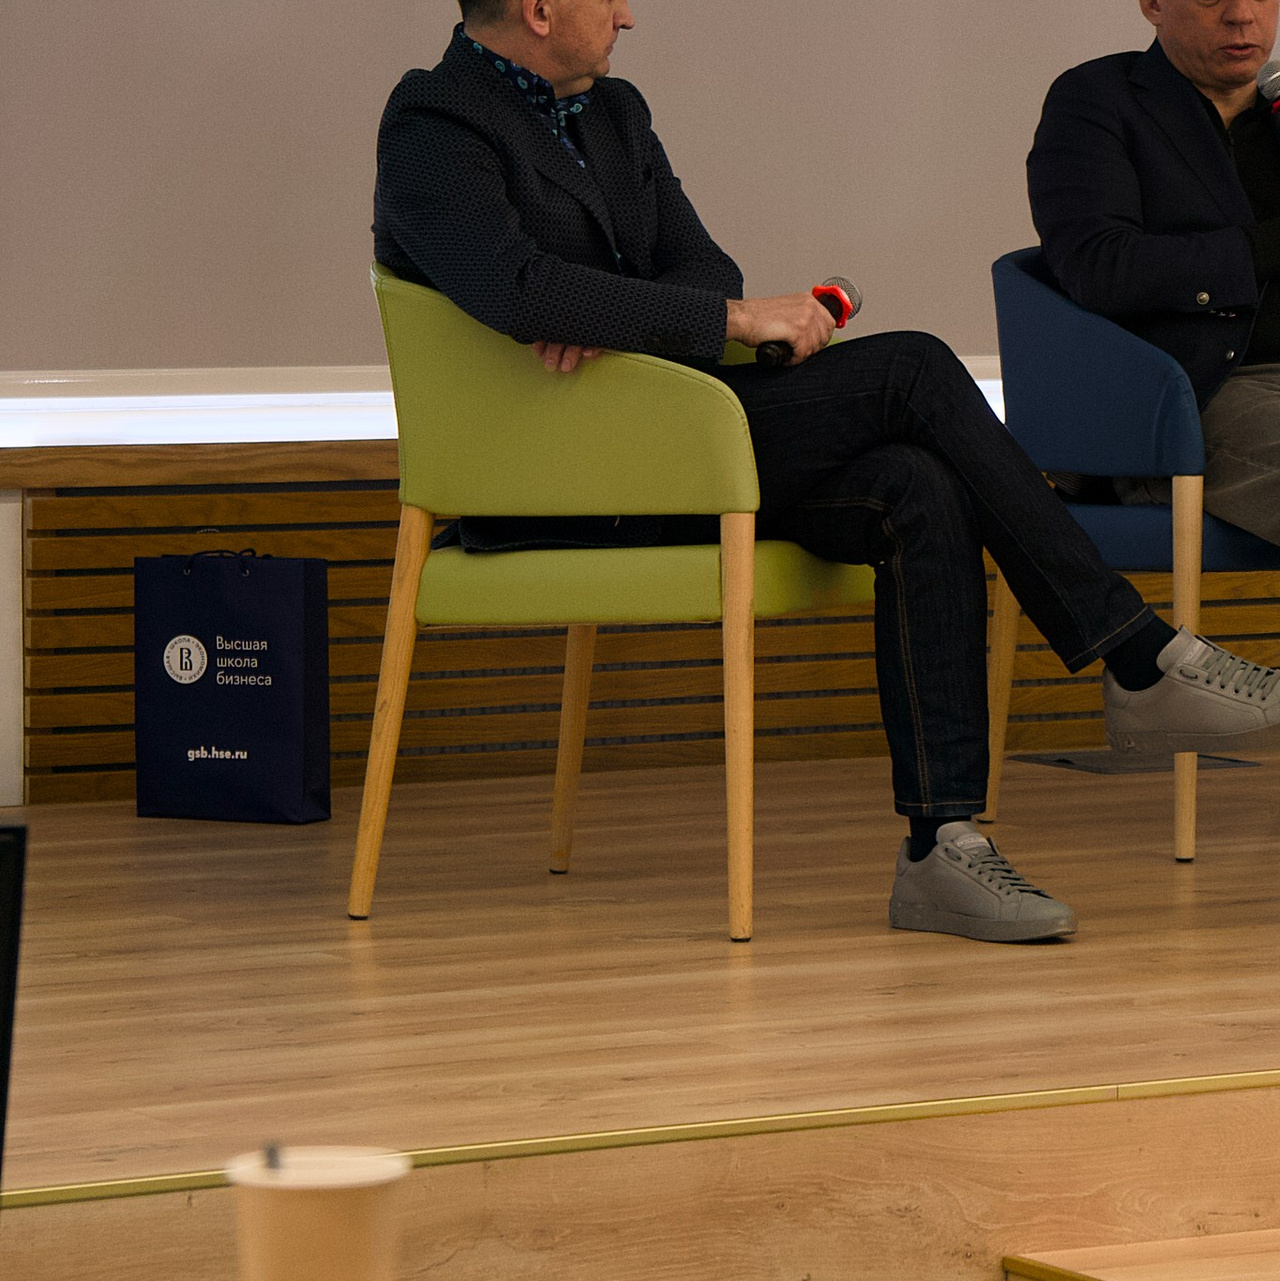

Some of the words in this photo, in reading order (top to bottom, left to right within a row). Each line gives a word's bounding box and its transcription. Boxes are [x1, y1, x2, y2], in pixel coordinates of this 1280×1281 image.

[216, 635, 268, 651] Высшая
[216, 657, 258, 669] школа
[216, 671, 272, 686] бизнеса
[187, 746, 248, 762] gsb.hse.ru
